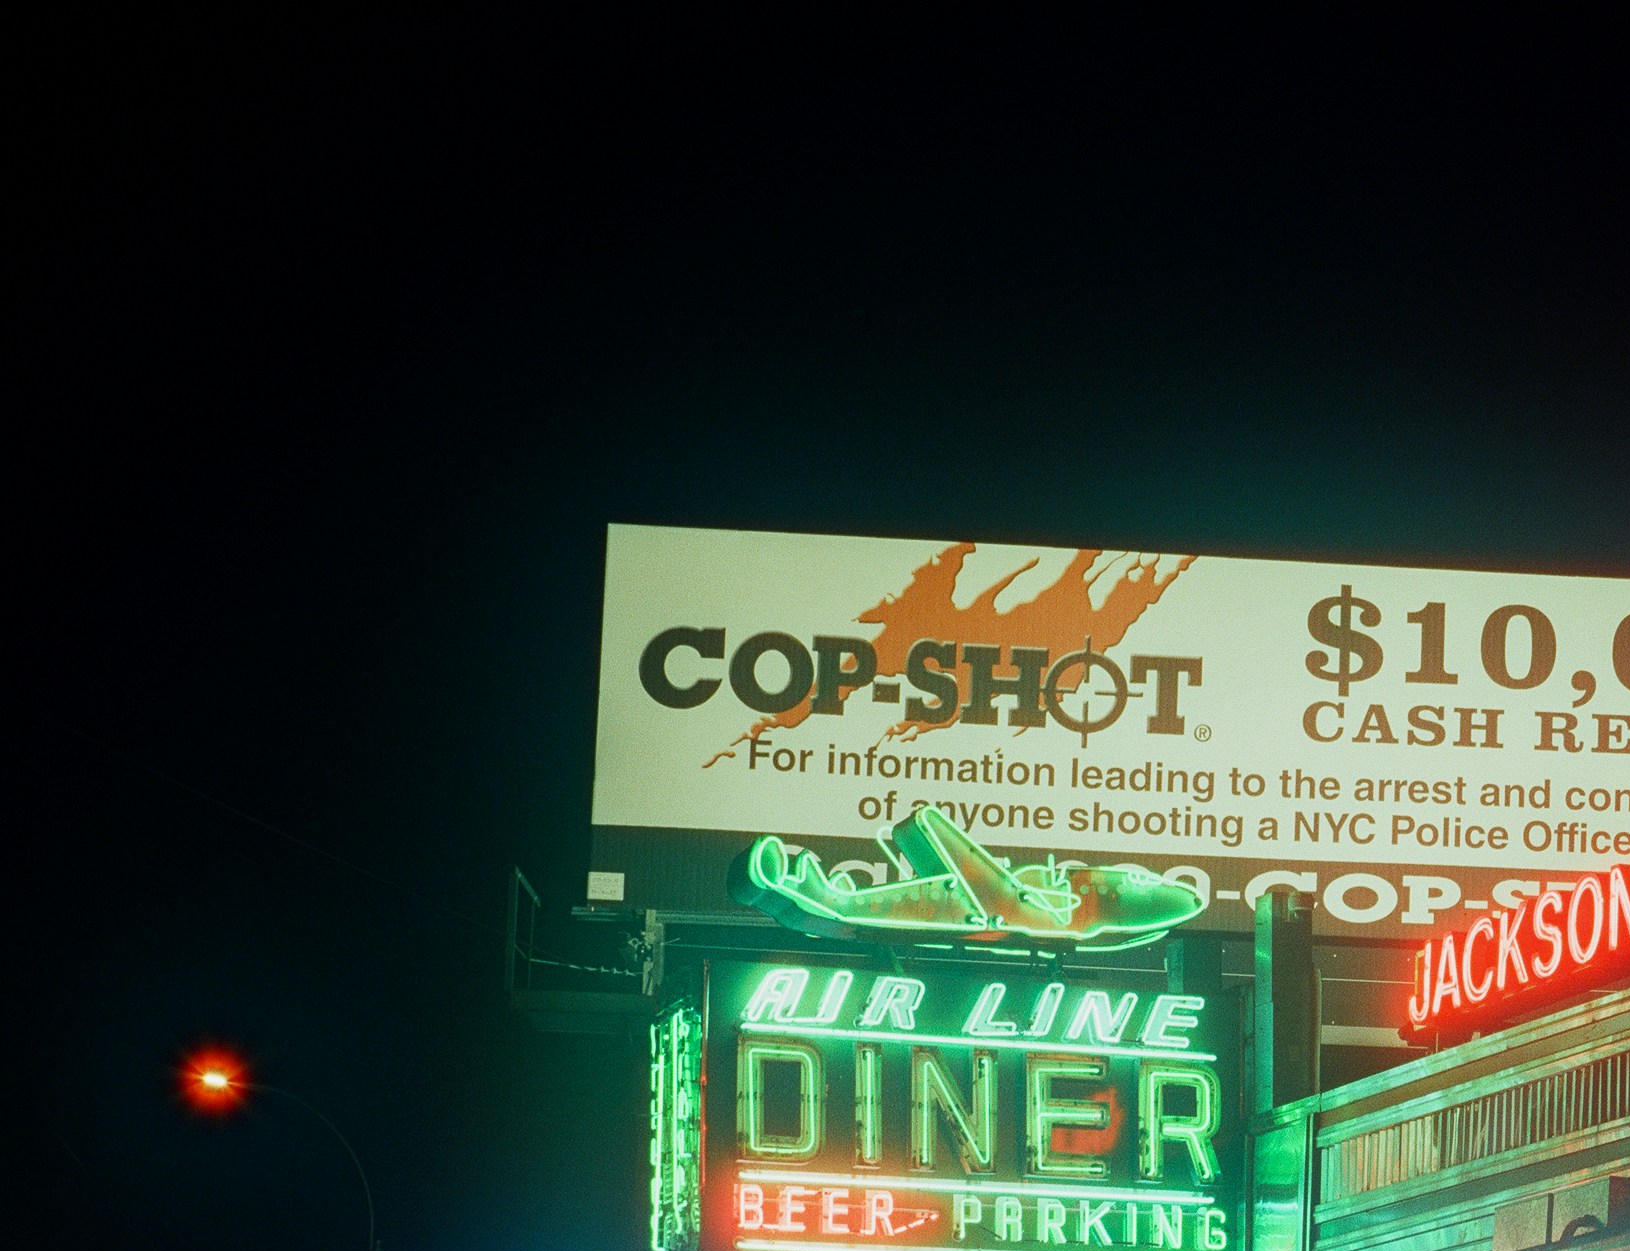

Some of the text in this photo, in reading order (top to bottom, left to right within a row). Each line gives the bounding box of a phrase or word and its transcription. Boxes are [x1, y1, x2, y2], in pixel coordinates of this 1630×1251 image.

[638, 625, 1202, 749] COP-SHOT
[1302, 701, 1505, 749] CASH
[749, 738, 814, 774] For
[828, 742, 1055, 787] information
[1071, 757, 1215, 803] leading
[1229, 767, 1266, 797] to
[1280, 769, 1341, 801] the
[1355, 776, 1467, 806] arrest
[1480, 779, 1551, 809] and
[858, 790, 898, 822] of
[1068, 802, 1244, 848] shooting
[1258, 818, 1278, 841] a
[1295, 811, 1376, 845] NYC
[1392, 814, 1509, 850] Police
[744, 968, 1206, 1049] AIR LINE
[737, 1037, 1221, 1186] DINER
[736, 1184, 1228, 1251] BEER PARKING
